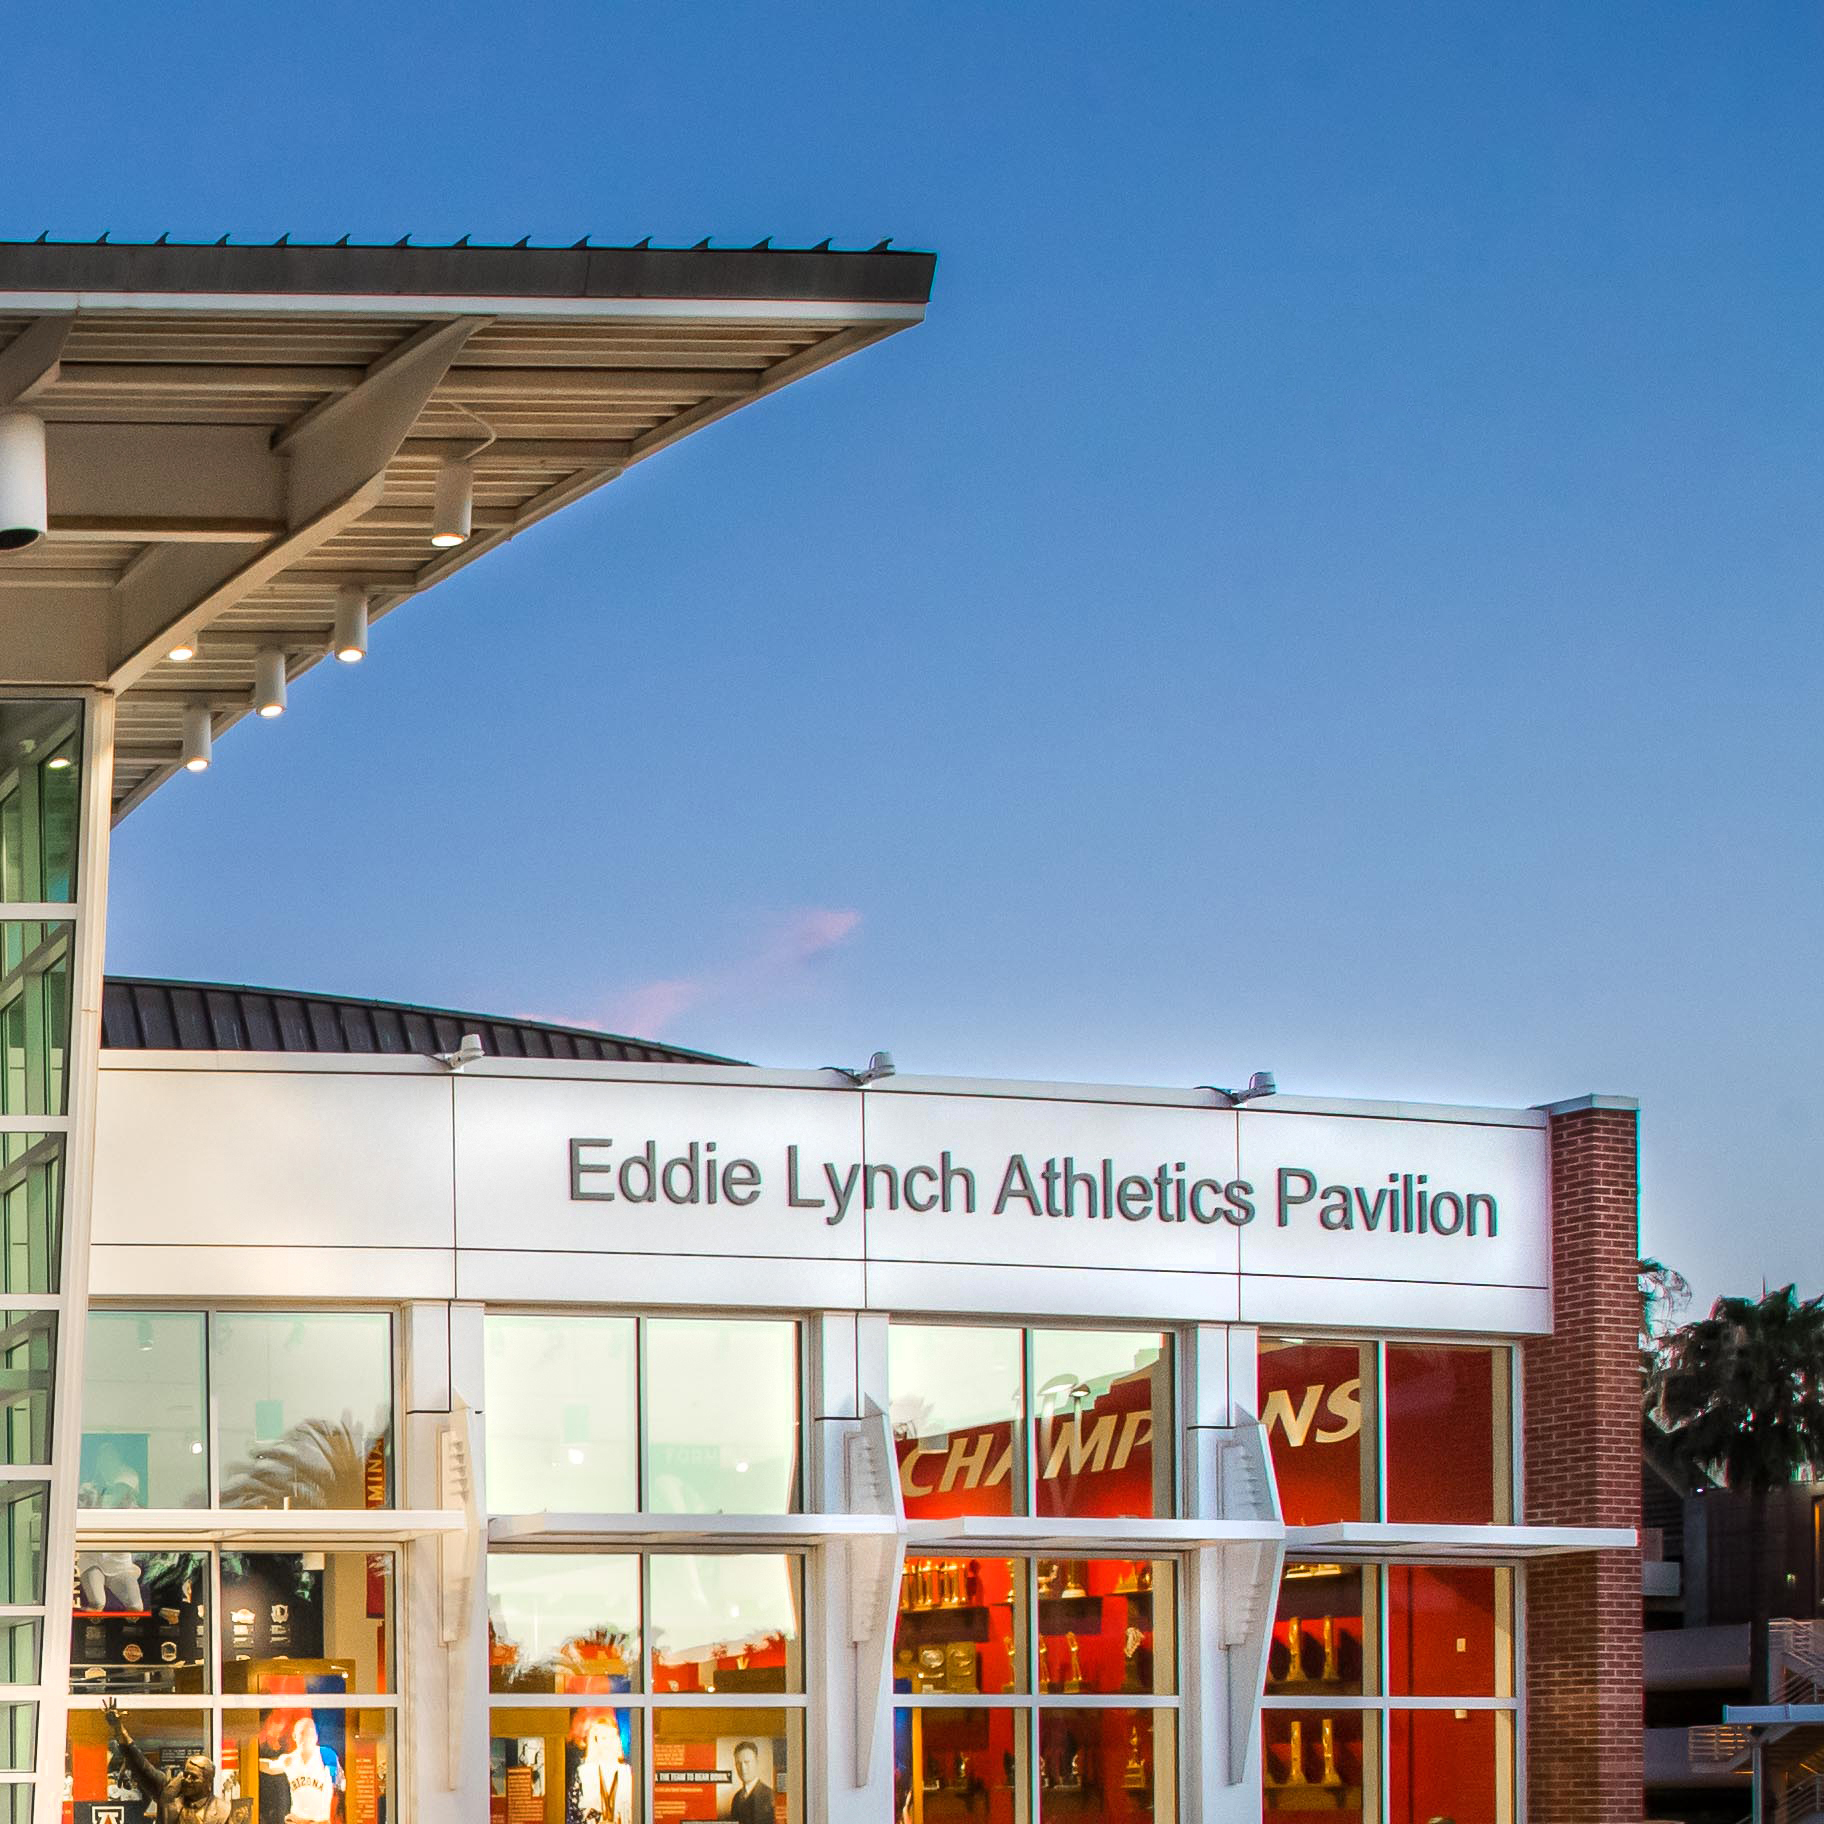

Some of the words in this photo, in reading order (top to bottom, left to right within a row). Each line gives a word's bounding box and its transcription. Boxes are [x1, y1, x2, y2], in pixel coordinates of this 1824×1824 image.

[569, 1138, 761, 1206] Eddie
[785, 1144, 977, 1225] Lynch
[994, 1154, 1256, 1227] Athletics
[1277, 1167, 1499, 1238] Pavilion
